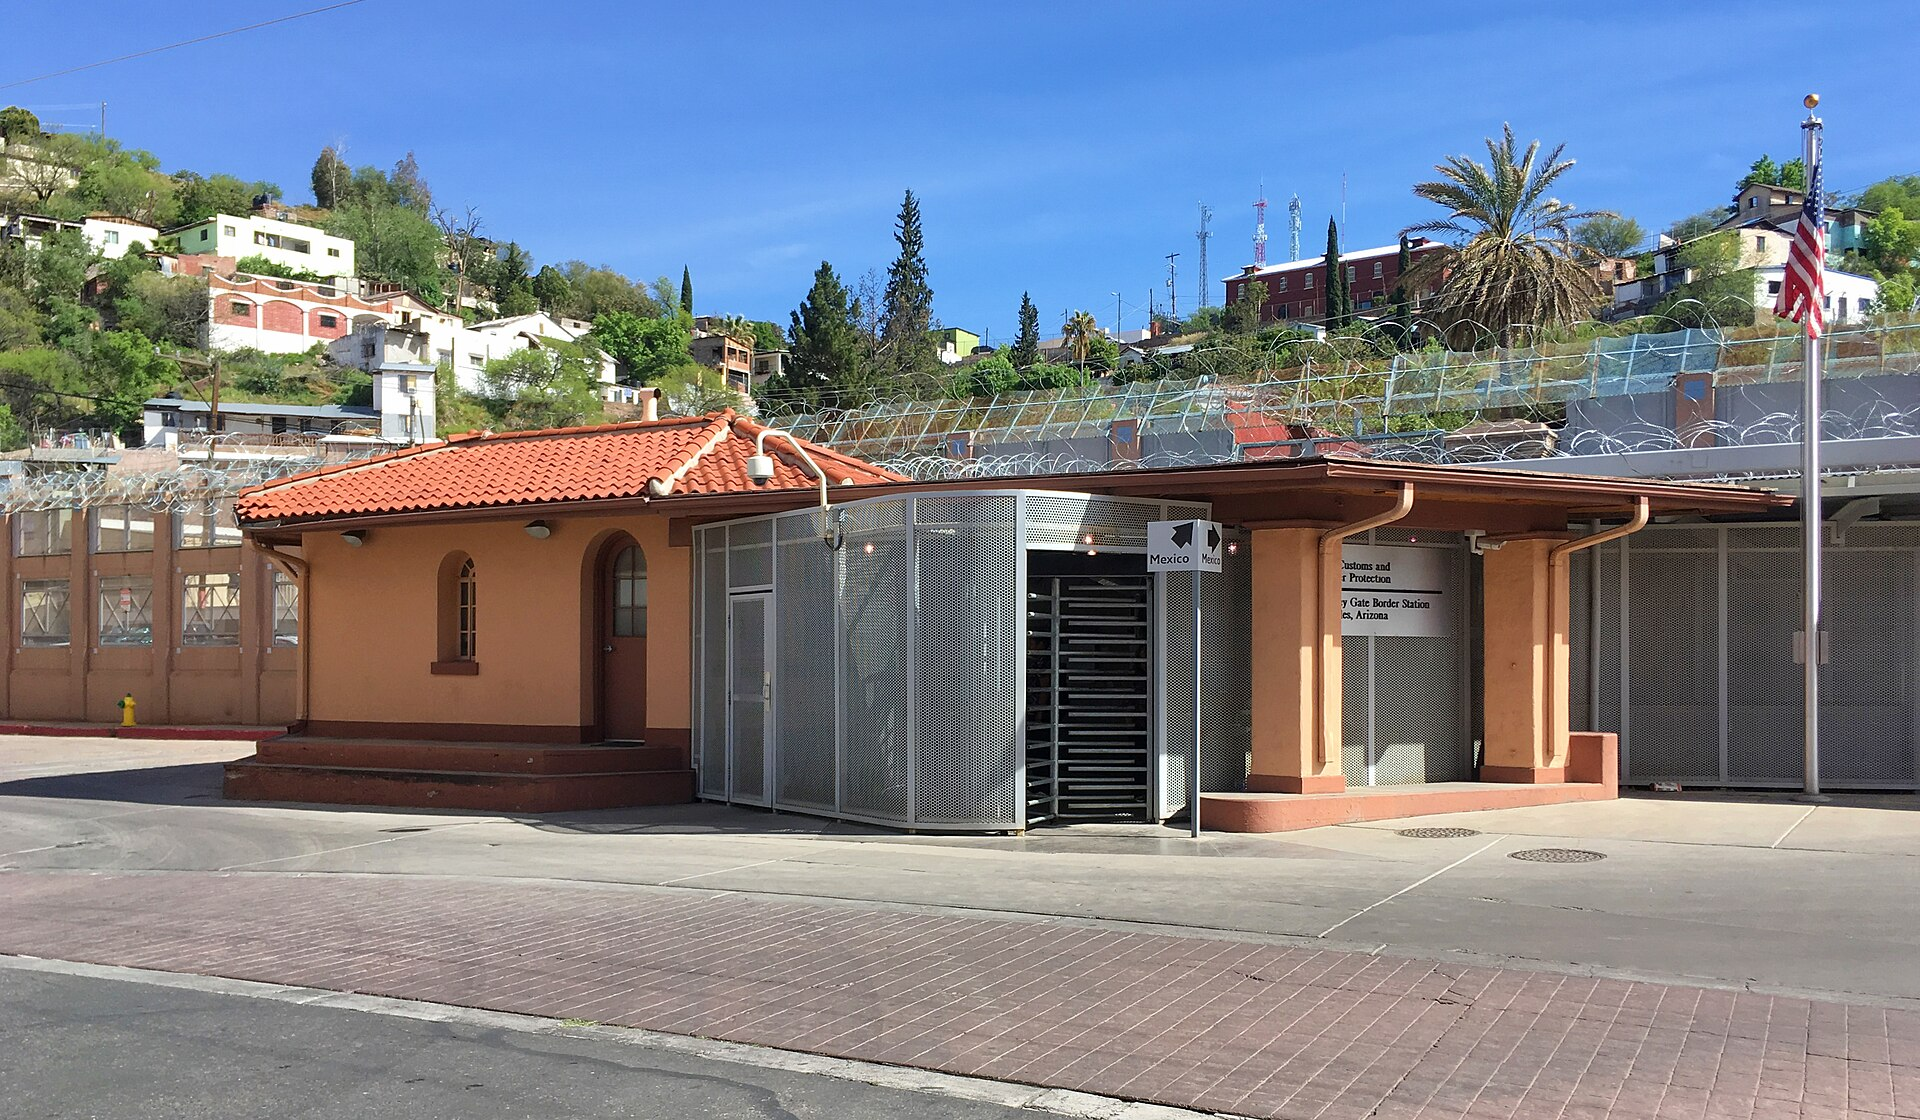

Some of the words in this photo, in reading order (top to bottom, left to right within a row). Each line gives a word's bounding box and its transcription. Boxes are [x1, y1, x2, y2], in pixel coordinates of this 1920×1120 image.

[1150, 553, 1189, 564] Mexico
[1202, 553, 1220, 565] Mexico
[1375, 562, 1391, 571] and
[1349, 573, 1391, 583] Protection
[1350, 597, 1370, 608] Gate
[1372, 598, 1400, 608] Border
[1402, 598, 1430, 609] Station
[1356, 609, 1389, 620] Arizona
